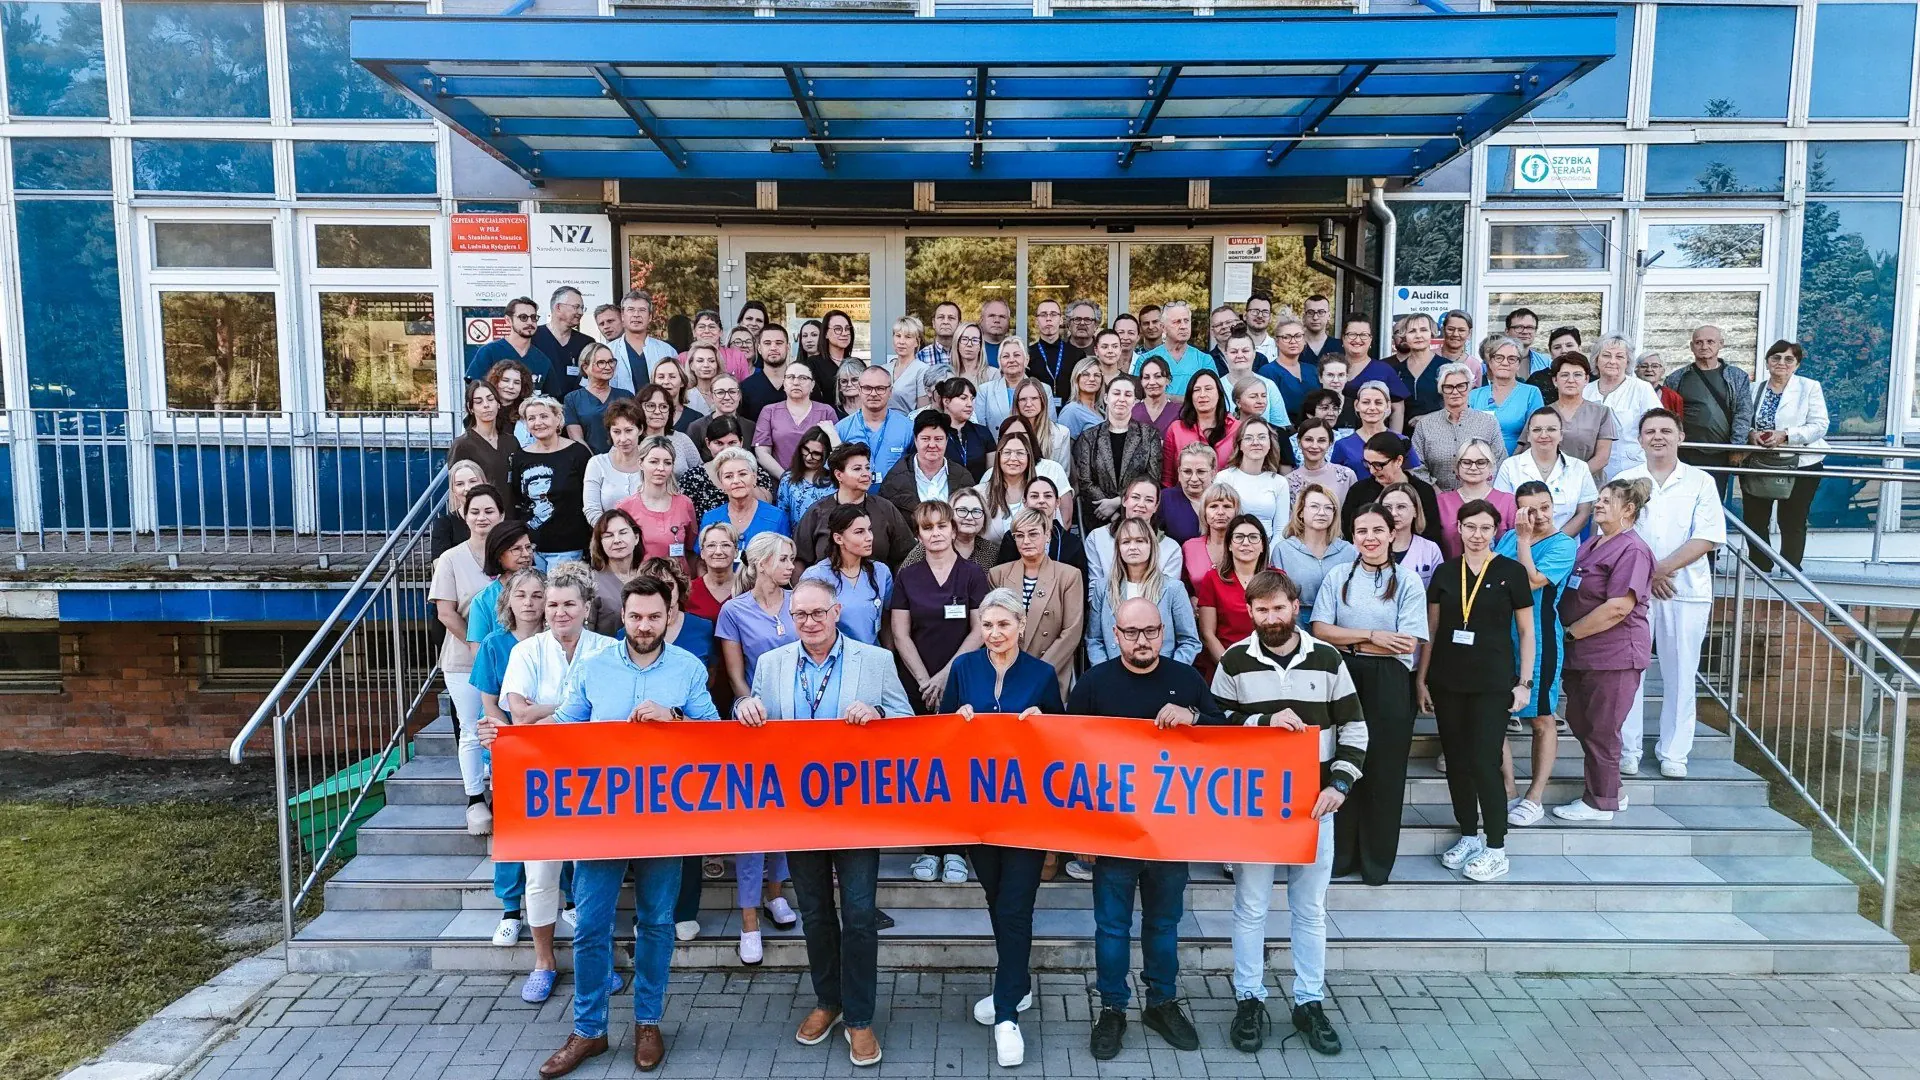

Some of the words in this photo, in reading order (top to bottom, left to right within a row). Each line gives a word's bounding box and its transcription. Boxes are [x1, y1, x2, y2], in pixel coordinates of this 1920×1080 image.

[1552, 156, 1592, 165] SZYBKA
[1553, 166, 1591, 175] TERAPIA
[549, 224, 594, 244] NFZ
[1411, 290, 1449, 300] Audika
[525, 762, 785, 818] BEZPIECZNA
[800, 757, 952, 808] OPIEKA
[969, 757, 1027, 804] NA
[1042, 761, 1137, 813] CAŁE
[1152, 750, 1264, 818] ŻYCIE
[1280, 769, 1292, 819] !
